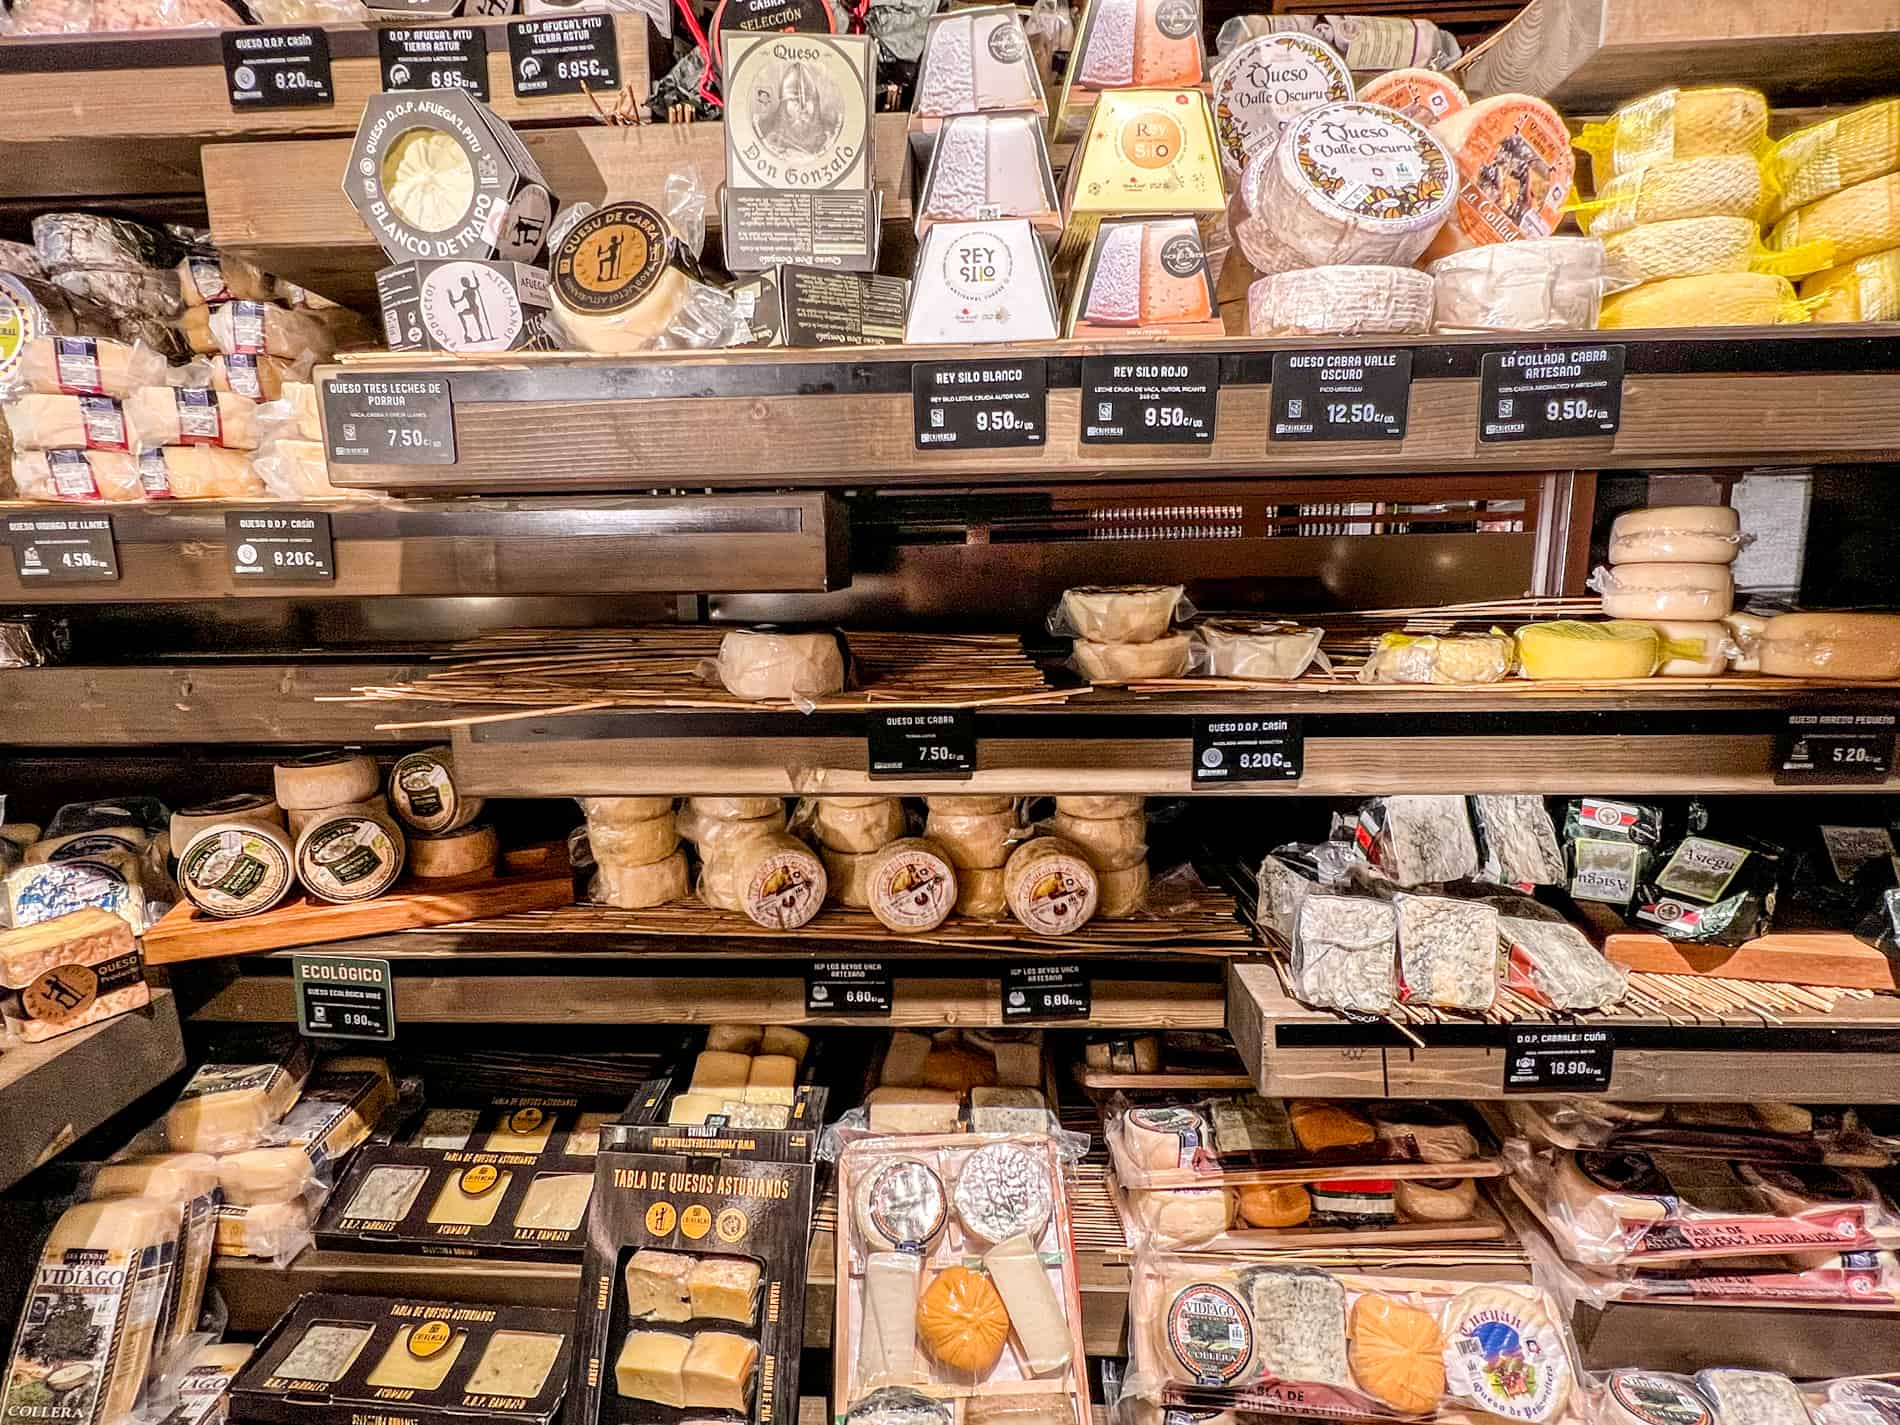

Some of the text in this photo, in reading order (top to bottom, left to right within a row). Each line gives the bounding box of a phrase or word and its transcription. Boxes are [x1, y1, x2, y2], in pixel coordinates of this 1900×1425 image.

[582, 18, 602, 29] PITU
[740, 7, 802, 31] SELECCIÓN
[453, 30, 473, 40] PITU
[533, 31, 590, 44] TIERRA ASTUR
[236, 39, 262, 49] QUESO
[404, 41, 460, 51] TIERRA ASTUR
[773, 44, 820, 60] Queso
[1246, 62, 1308, 88] Queso
[1235, 89, 1324, 107] Valle Oscuru
[366, 101, 482, 154] QUESO D.O.P. AFUEGA'L PITU
[1321, 122, 1388, 143] Queso
[1314, 143, 1412, 157] Valle Oscuru
[743, 141, 854, 185] Don Gonzalo
[1460, 182, 1520, 243] La Collad
[371, 194, 491, 257] BLANCO DE TRAPO
[564, 212, 660, 254] QUESU DE CABRA
[960, 247, 995, 264] REY
[485, 270, 518, 339] ASTURIANOS
[1290, 355, 1396, 368] QUESO CABRA VALLE
[1518, 350, 1607, 366] COLLADA CABRA
[936, 369, 1023, 384] REY SILO BLANCO
[1113, 366, 1188, 378] REY SILO ROJO
[1321, 369, 1363, 380] OSCURO
[1525, 366, 1581, 379] ARTESANO
[330, 383, 440, 393] QUESO TRES LECHES DE
[368, 396, 406, 406] PORRUA
[240, 520, 265, 528] QUESO
[887, 717, 912, 725] QUESO
[927, 716, 954, 724] CABRA
[1208, 723, 1236, 732] QUESO
[1685, 849, 1735, 877] Asiegu
[1578, 873, 1629, 892] Asiegu
[98, 955, 137, 976] QUESO
[301, 963, 382, 982] ECOLÓGICO
[614, 1169, 789, 1199] TABLA DE QUESOS ASTURIANOS
[41, 1269, 124, 1286] VIDIAGO
[390, 1304, 412, 1316] TABLA
[413, 1306, 424, 1316] DE
[424, 1307, 452, 1319] QUESOS
[1184, 1301, 1236, 1316] VIDIAGO
[1287, 1391, 1304, 1401] DE
[8, 1406, 84, 1419] COLLERA
